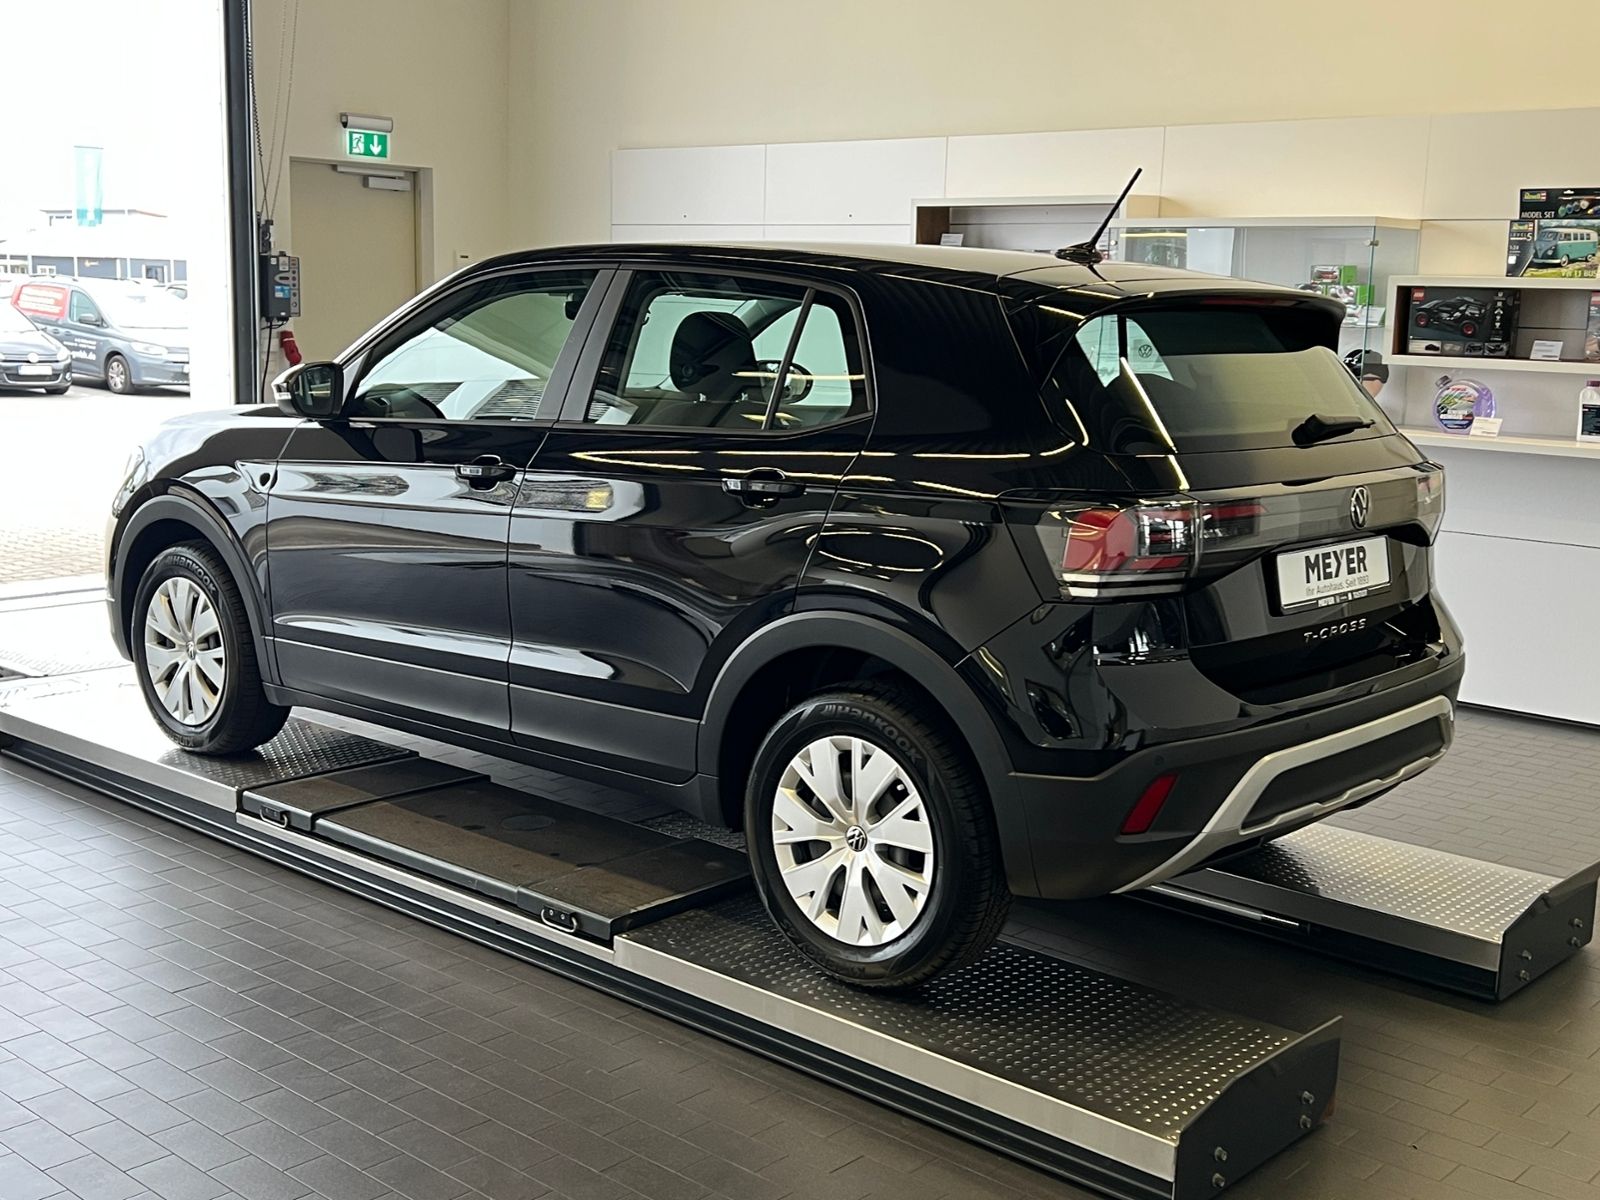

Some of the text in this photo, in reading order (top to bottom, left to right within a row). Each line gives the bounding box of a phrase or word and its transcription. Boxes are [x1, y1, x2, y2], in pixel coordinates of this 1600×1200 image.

[1521, 211, 1543, 219] MODEL
[1527, 232, 1533, 242] 5
[1304, 545, 1368, 584] MEYER
[1303, 618, 1367, 644] T-CROSS
